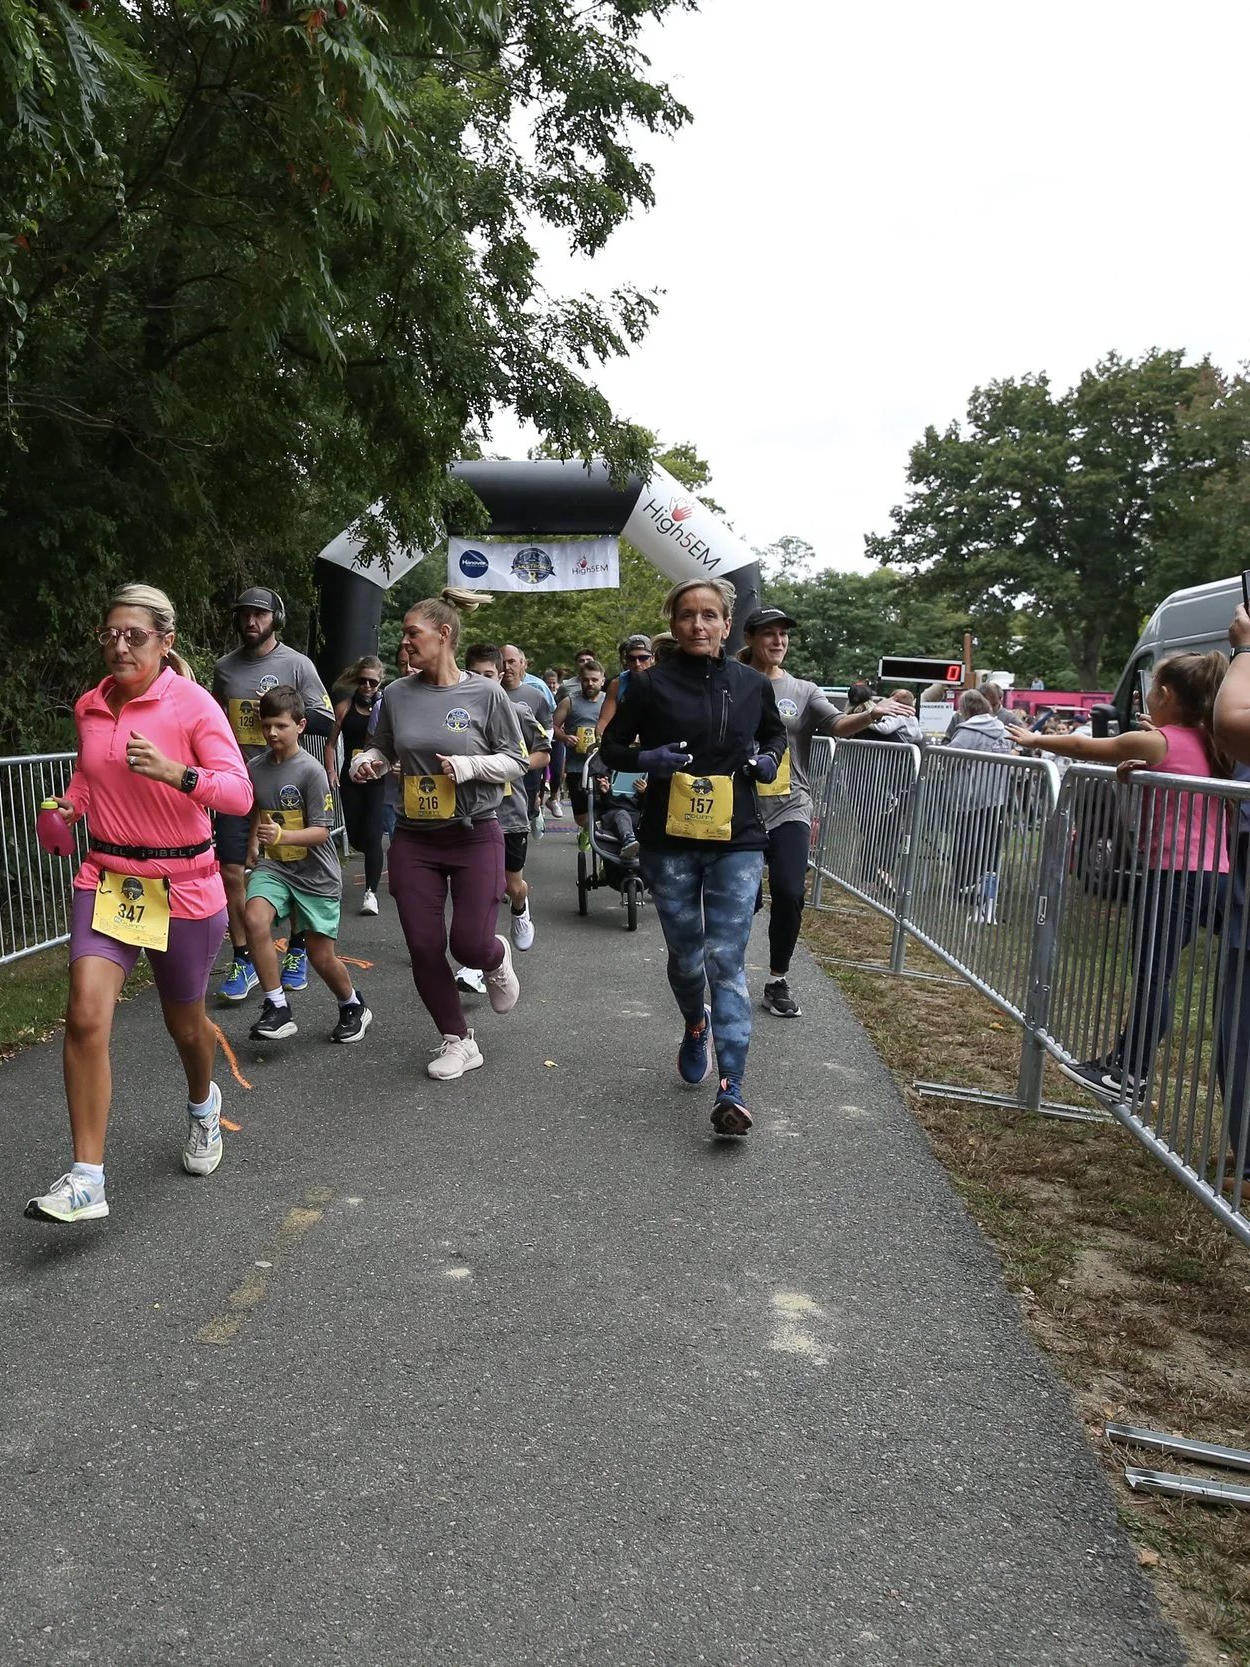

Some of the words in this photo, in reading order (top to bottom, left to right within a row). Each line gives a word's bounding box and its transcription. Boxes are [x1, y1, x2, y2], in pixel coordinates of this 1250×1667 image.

[643, 498, 722, 571] High5EM
[572, 564, 608, 575] High5EM
[947, 665, 960, 680] 0
[239, 716, 254, 727] 129
[418, 796, 439, 810] 216
[690, 798, 714, 814] 157
[118, 903, 145, 923] 347
